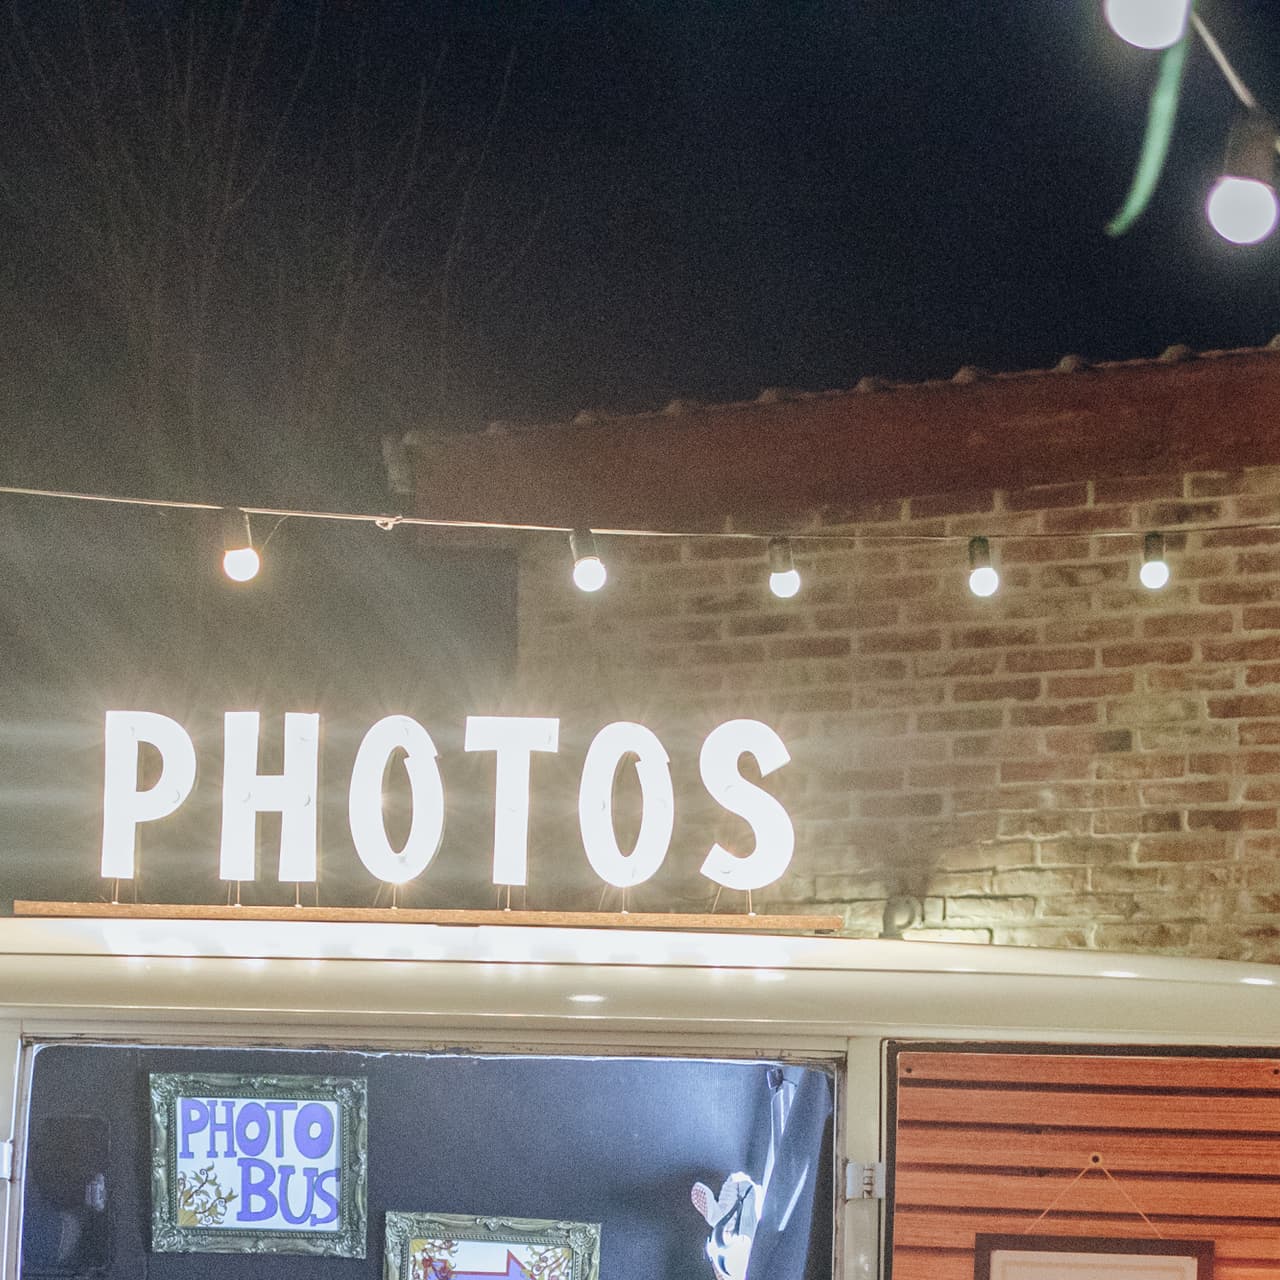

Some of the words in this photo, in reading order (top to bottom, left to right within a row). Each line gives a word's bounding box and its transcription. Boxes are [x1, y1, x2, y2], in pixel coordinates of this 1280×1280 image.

[101, 710, 795, 890] PHOTOS
[179, 1099, 334, 1159] PHOTO
[236, 1157, 341, 1226] BUS
